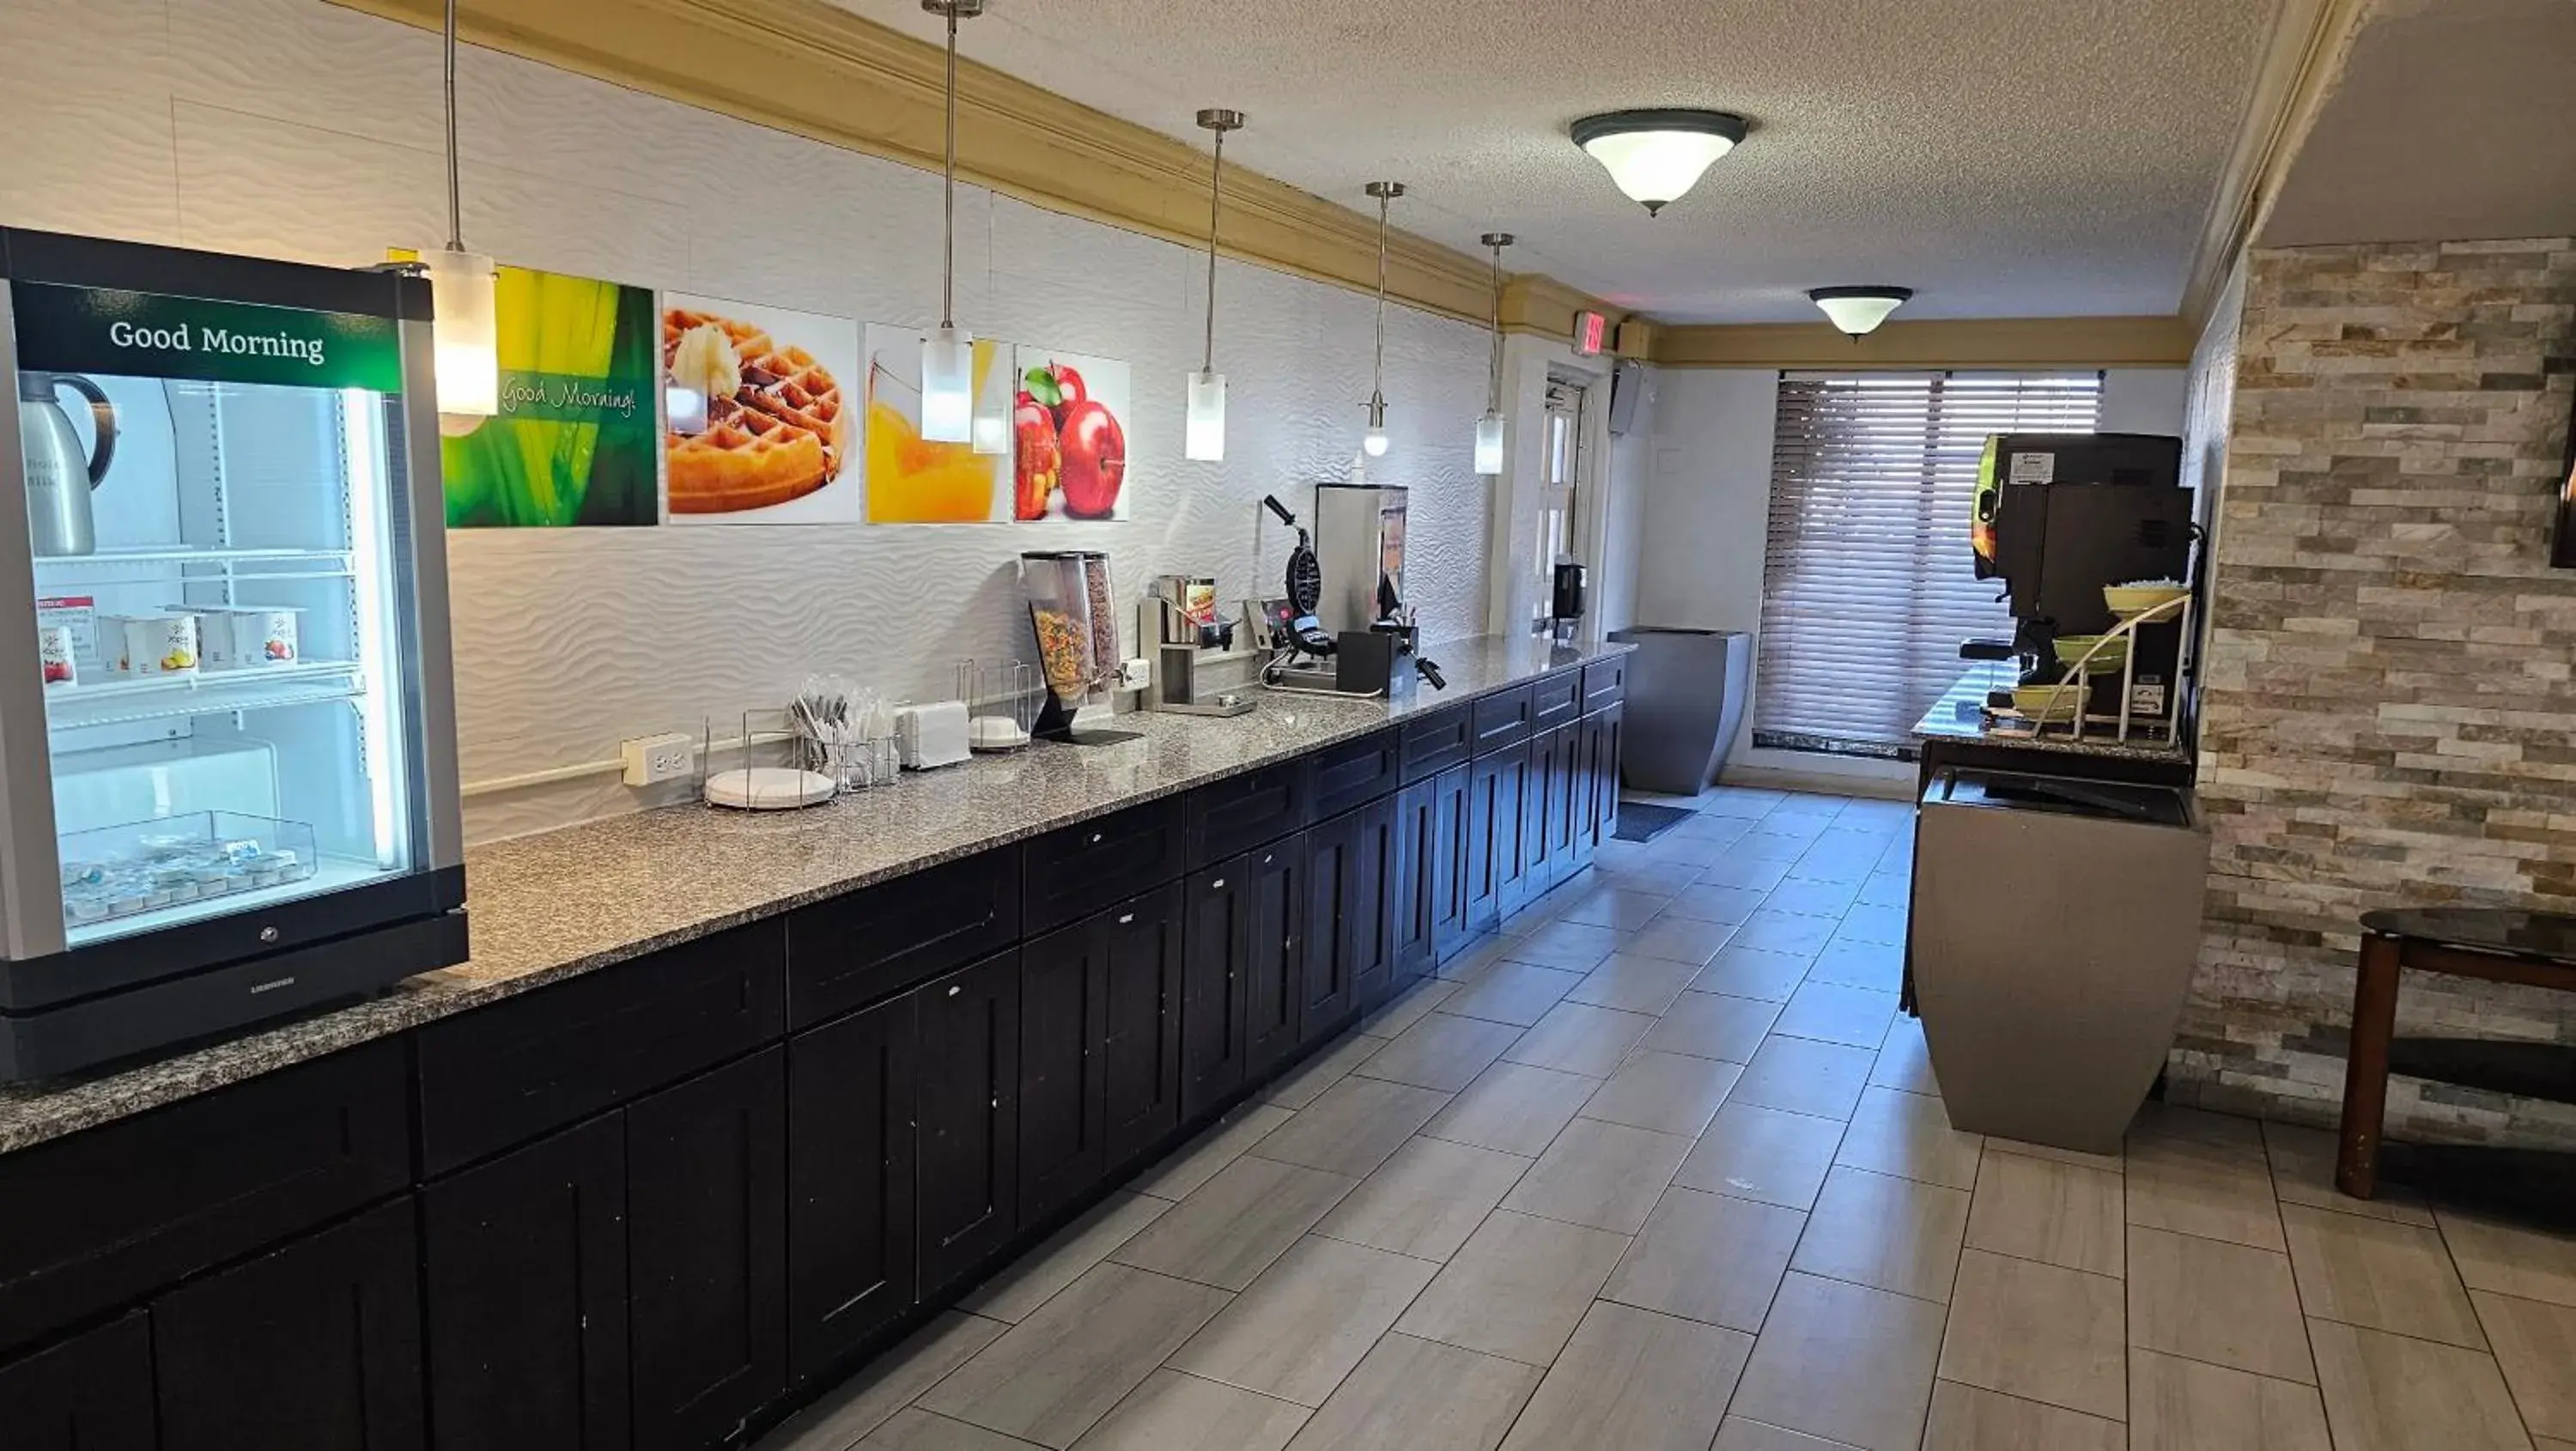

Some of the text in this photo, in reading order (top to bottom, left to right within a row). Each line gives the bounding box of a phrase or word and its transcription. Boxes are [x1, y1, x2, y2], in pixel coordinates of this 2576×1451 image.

[110, 322, 325, 365] Good Morning
[502, 377, 636, 418] Good Morning!
